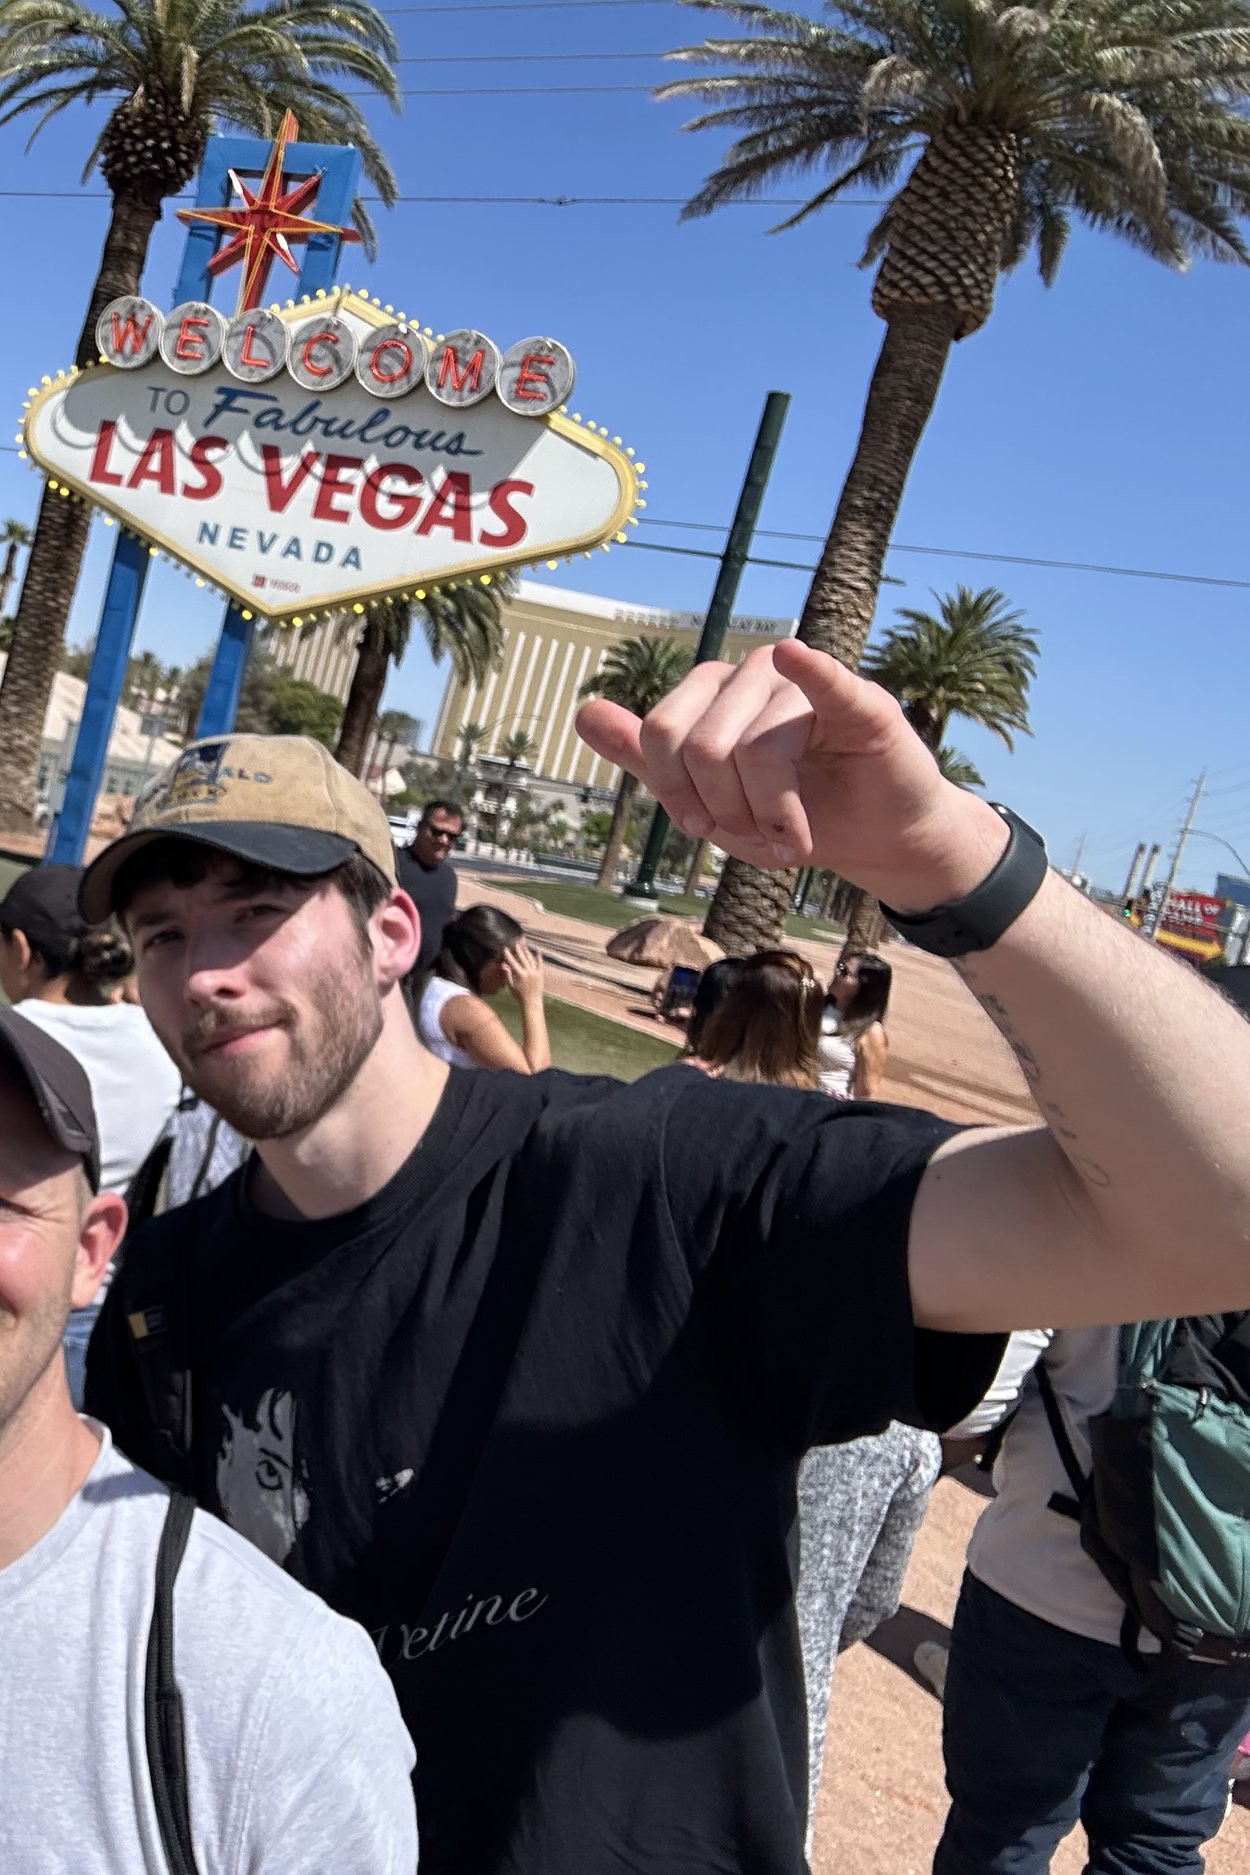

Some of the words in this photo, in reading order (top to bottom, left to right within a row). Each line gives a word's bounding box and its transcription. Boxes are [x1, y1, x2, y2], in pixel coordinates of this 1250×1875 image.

[112, 311, 555, 401] WELCOME
[147, 386, 190, 416] TO
[203, 386, 483, 458] Fabulous
[89, 419, 230, 501] LAS
[260, 443, 535, 549] VEGAS
[197, 521, 364, 572] NEVADA
